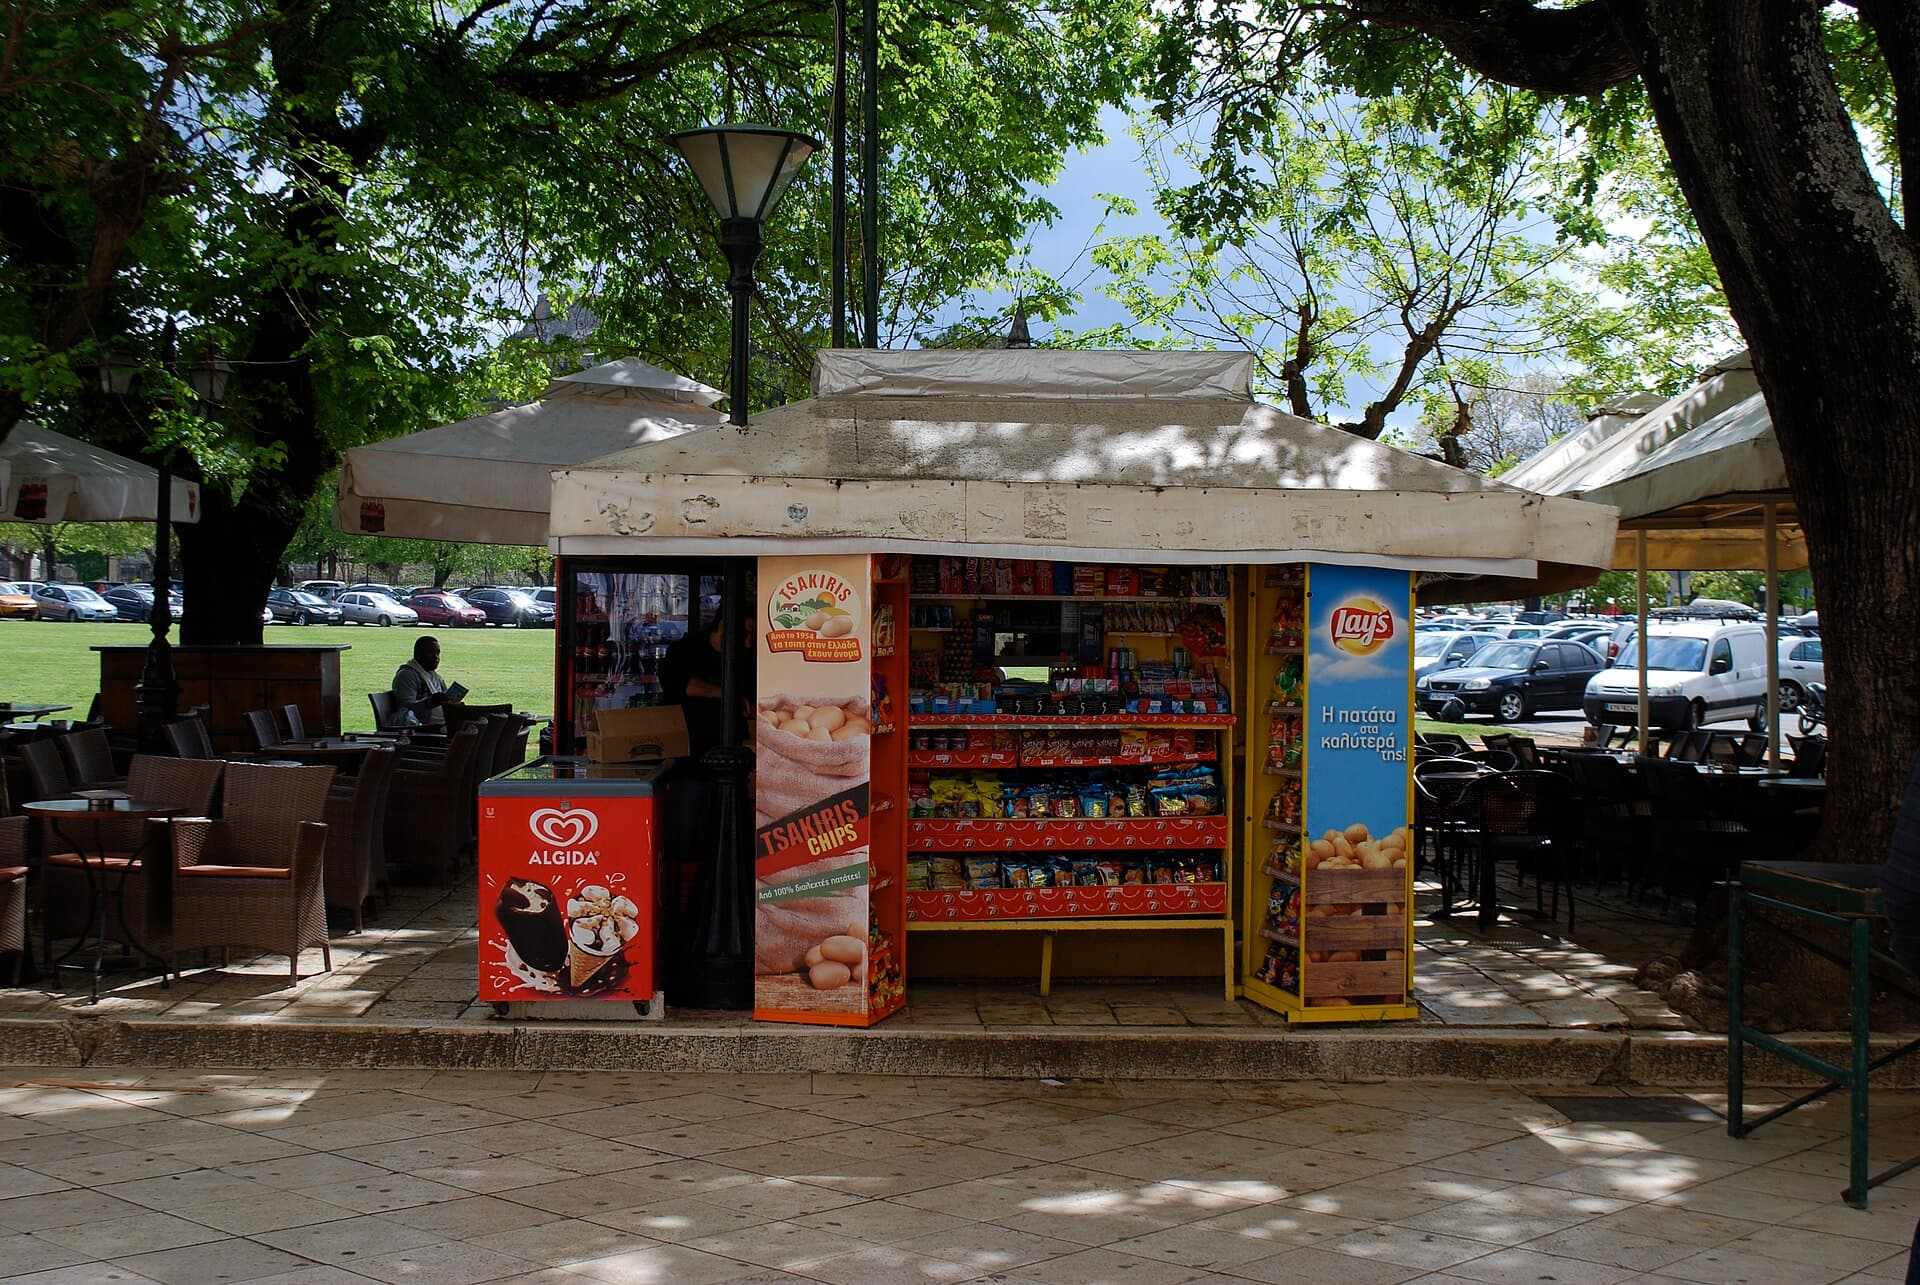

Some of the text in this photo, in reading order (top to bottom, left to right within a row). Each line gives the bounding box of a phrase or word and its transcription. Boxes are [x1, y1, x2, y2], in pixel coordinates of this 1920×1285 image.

[778, 574, 852, 602] TSAKIRIS
[796, 632, 814, 640] 1954
[1334, 609, 1391, 646] Lay's
[828, 640, 857, 649] Ελλάδα
[1322, 706, 1396, 723] Η πατάτα
[1360, 726, 1379, 734] στα
[1321, 733, 1395, 752] καλύτερά
[760, 799, 859, 855] TSAKIRIS
[807, 823, 858, 856] CHIPS
[529, 851, 598, 866] ALGIDA
[774, 886, 793, 897] 100%
